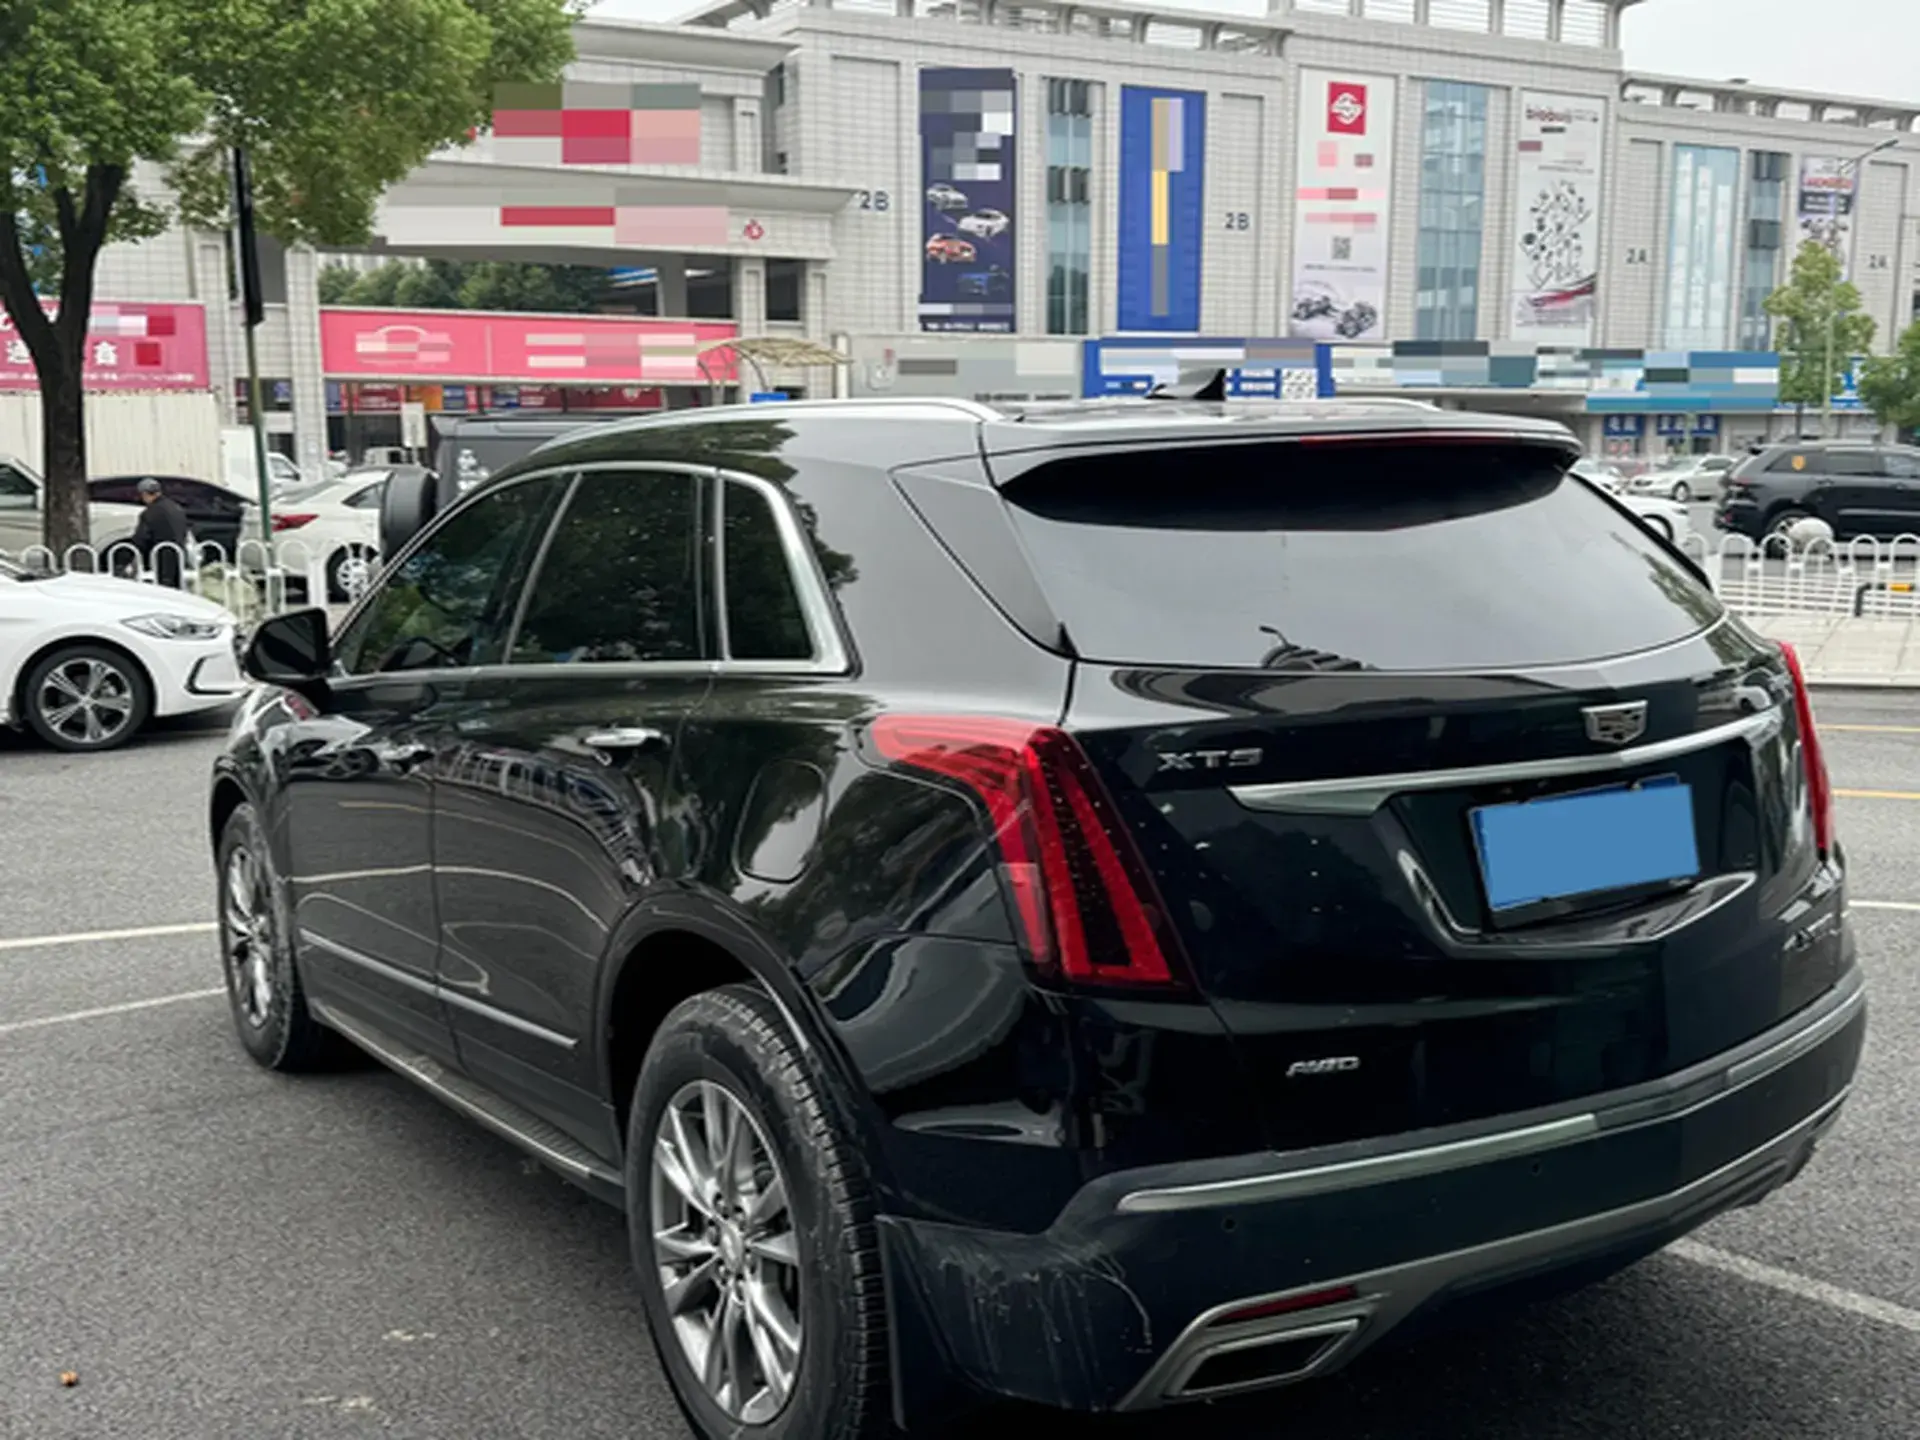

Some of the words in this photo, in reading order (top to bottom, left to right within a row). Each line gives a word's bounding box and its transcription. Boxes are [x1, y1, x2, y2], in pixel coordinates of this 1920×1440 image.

[859, 189, 889, 212] 2B
[1225, 211, 1250, 231] 2B
[1157, 747, 1263, 772] XT5
